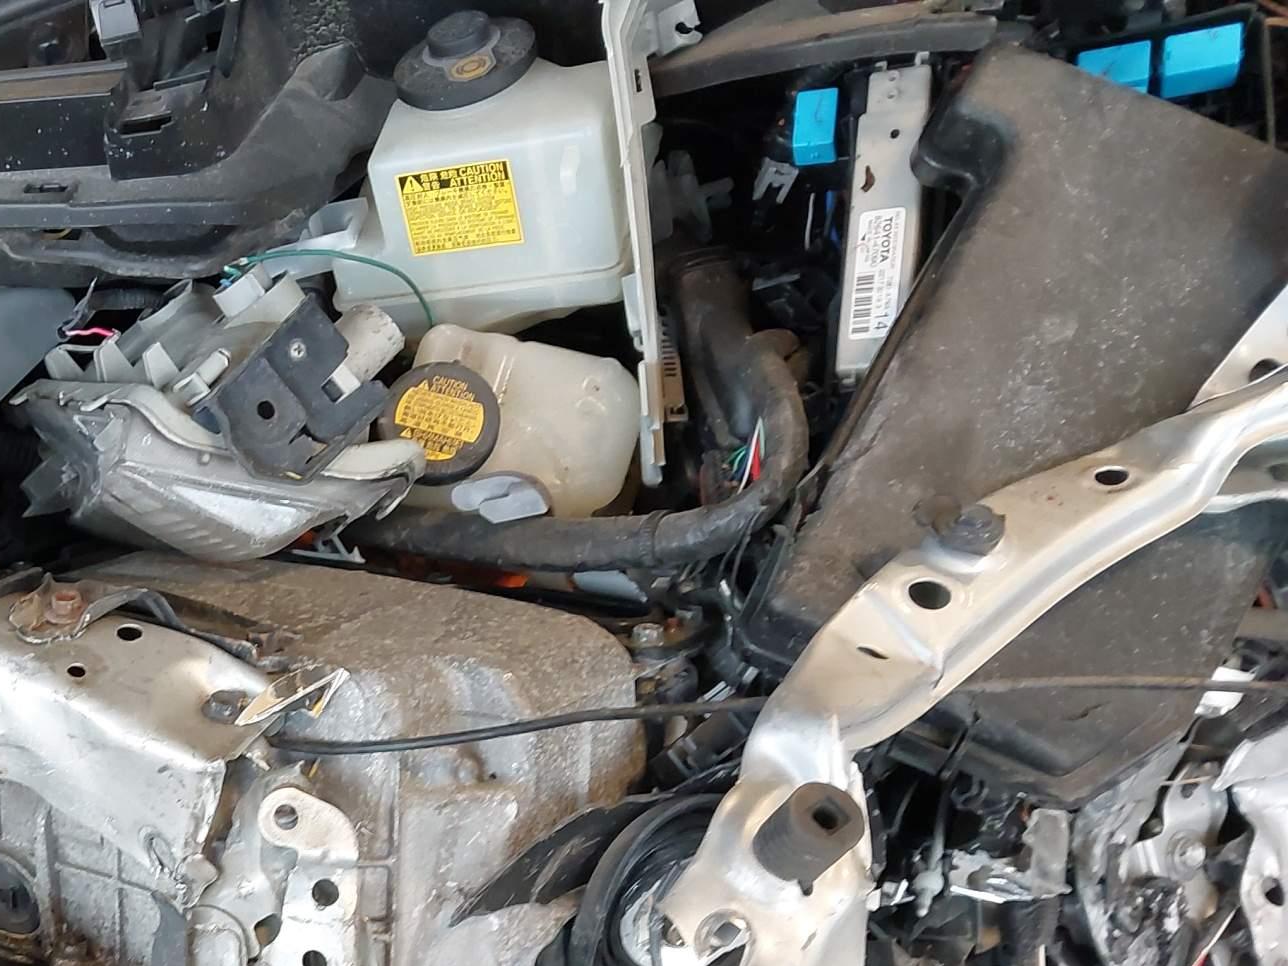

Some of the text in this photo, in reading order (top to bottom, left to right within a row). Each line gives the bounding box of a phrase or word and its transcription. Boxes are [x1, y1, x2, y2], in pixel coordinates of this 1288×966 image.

[459, 163, 503, 177] CAUTION
[450, 171, 505, 187] ATTENTION
[880, 216, 892, 263] TOYOTA
[874, 312, 889, 331] 14
[433, 376, 469, 389] CAUTION
[430, 385, 475, 401] ATTENTION
